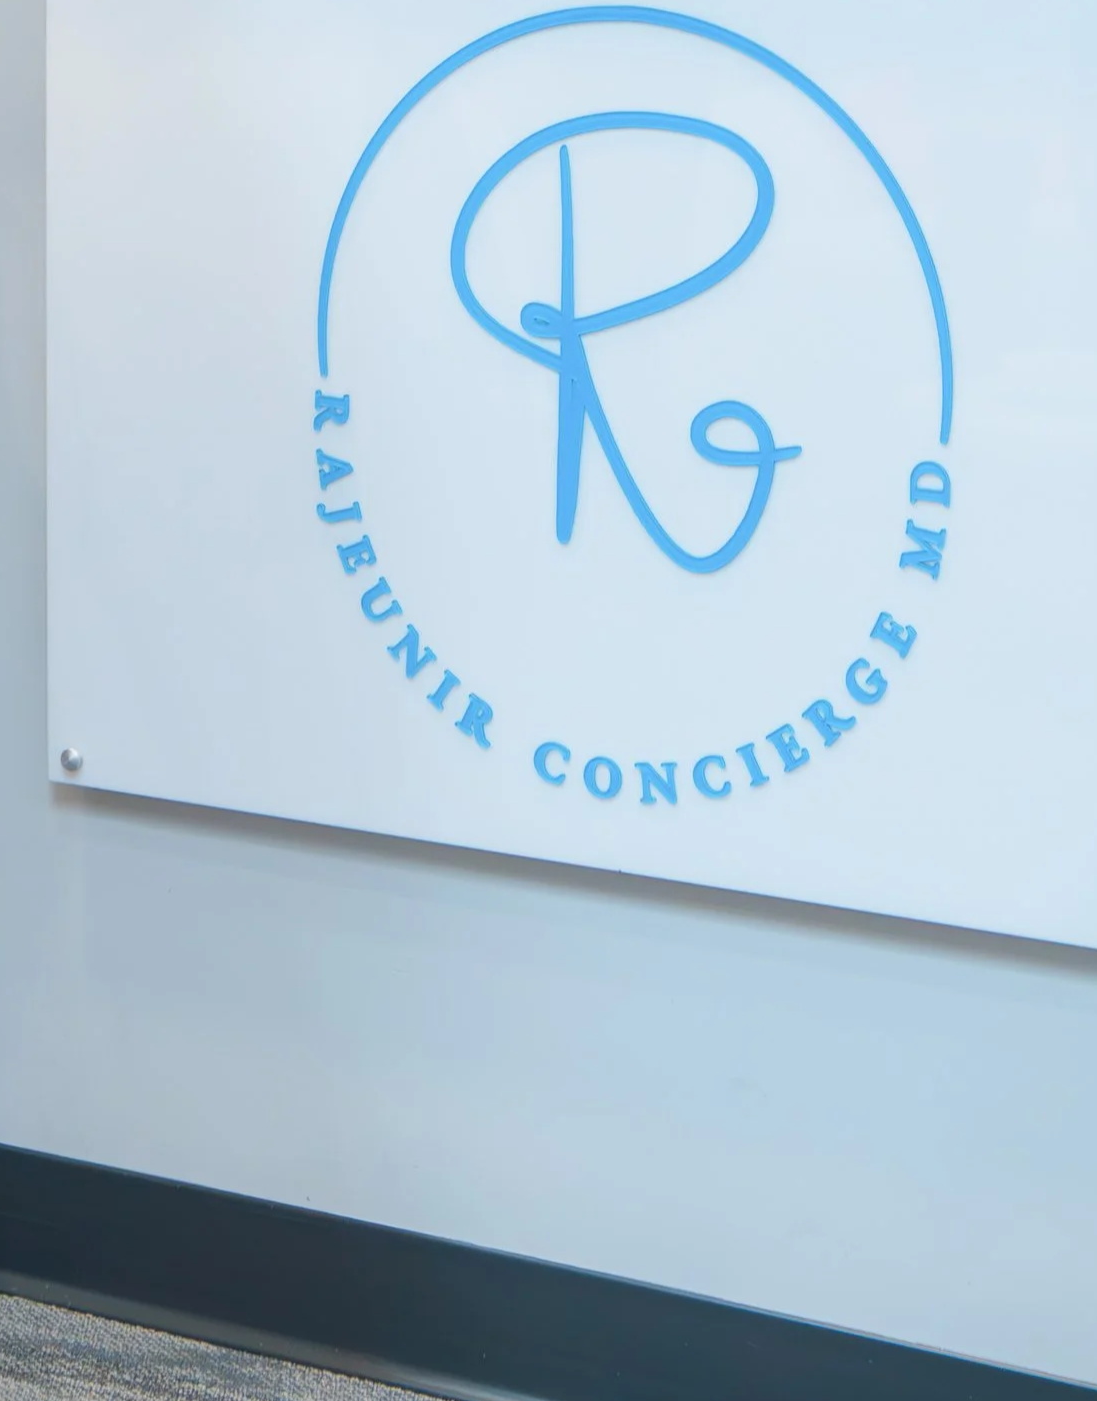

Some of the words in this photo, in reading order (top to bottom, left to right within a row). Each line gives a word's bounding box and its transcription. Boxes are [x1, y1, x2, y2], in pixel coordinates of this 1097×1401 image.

[312, 389, 494, 749] RAJEUNIR
[533, 611, 917, 805] CONCIERGE
[898, 460, 951, 580] MD
